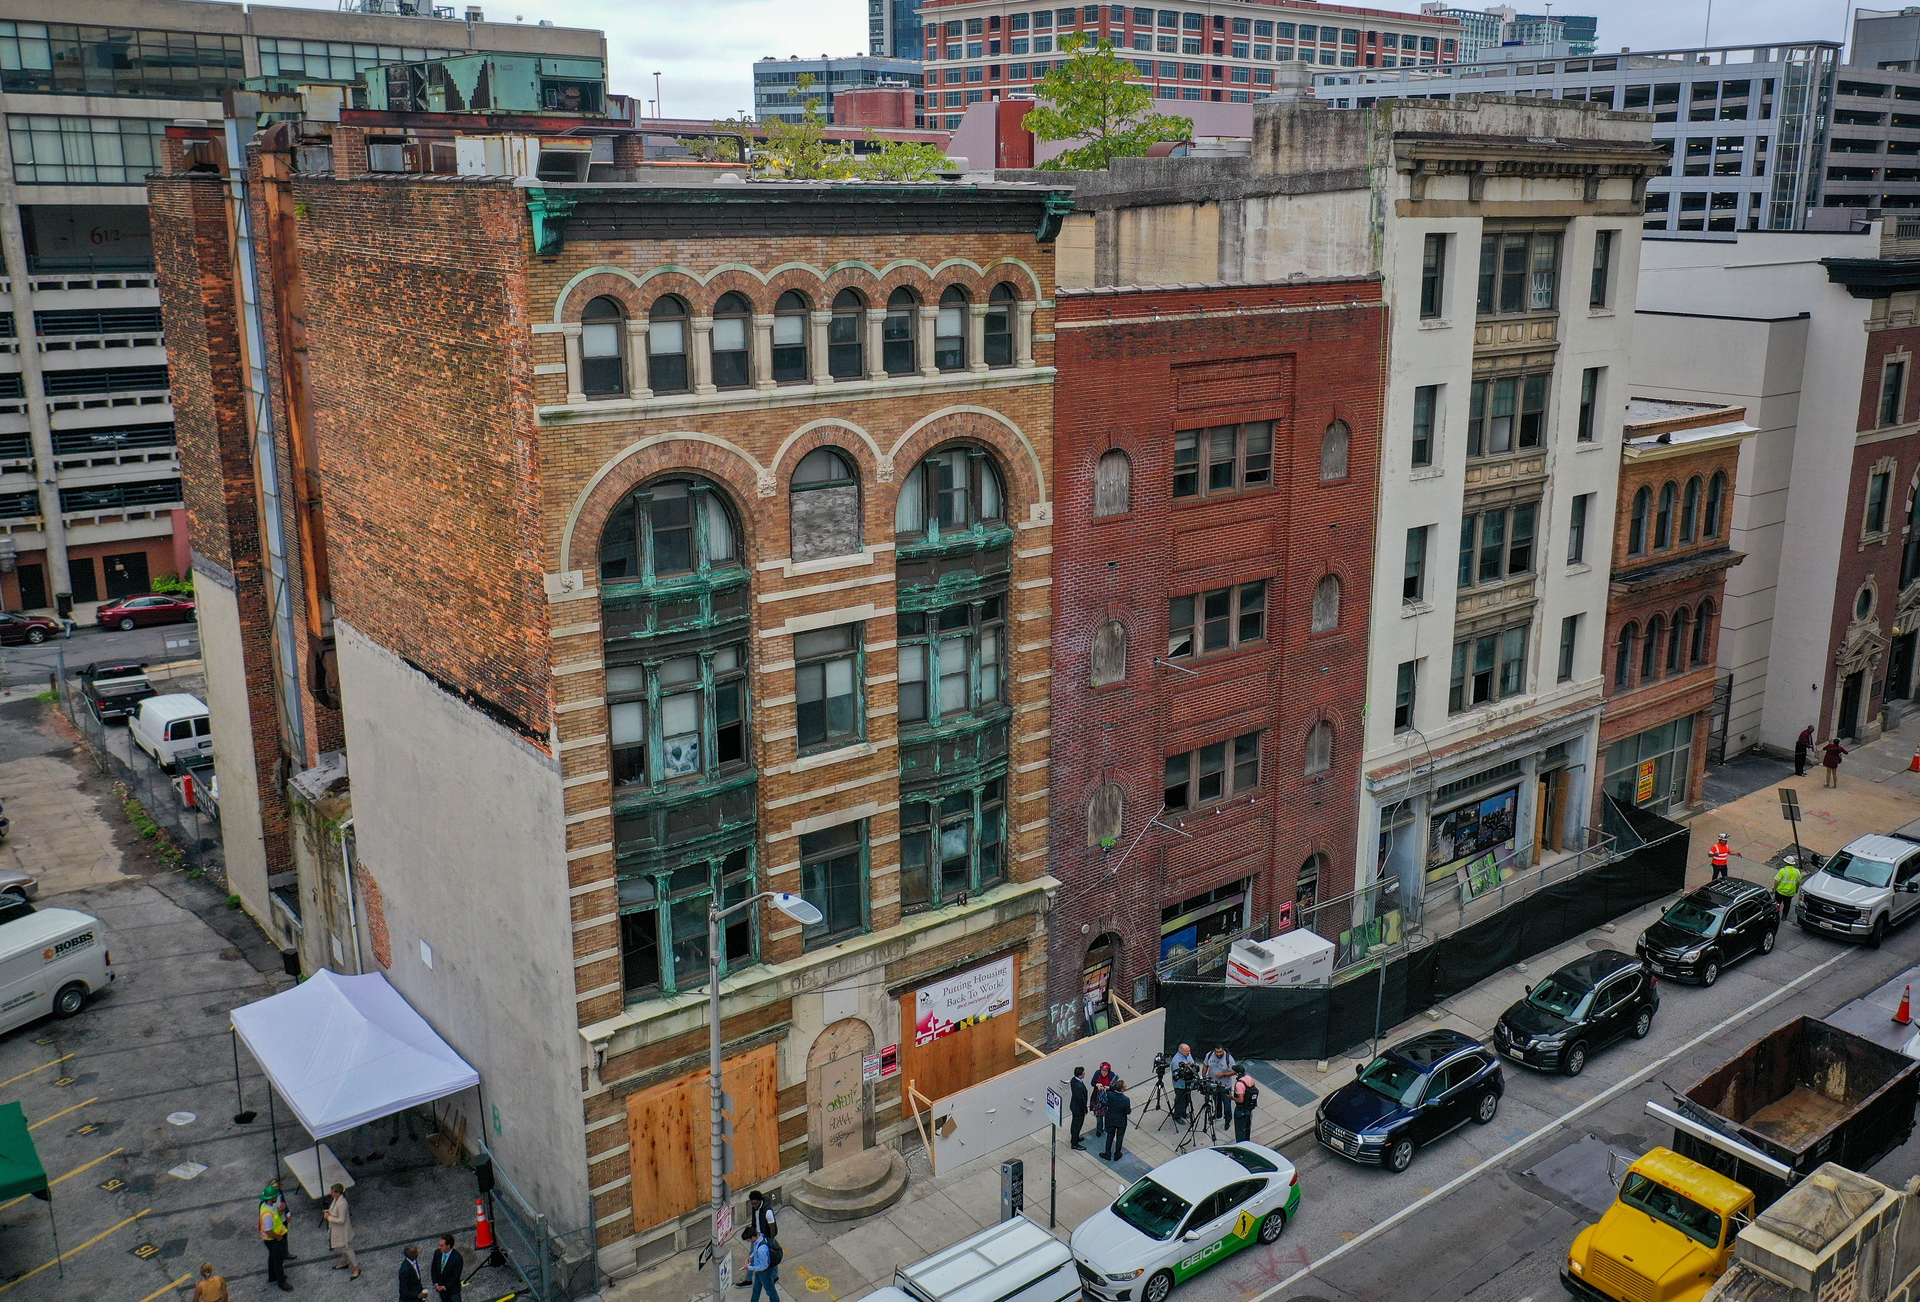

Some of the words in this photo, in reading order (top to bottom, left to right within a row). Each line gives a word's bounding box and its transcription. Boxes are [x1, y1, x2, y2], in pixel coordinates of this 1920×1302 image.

[54, 931, 94, 954] HOBBS
[943, 979, 972, 998] Putting
[974, 966, 1008, 984] Housing
[946, 994, 966, 1008] Back
[967, 988, 978, 999] To
[979, 978, 1004, 994] Work!
[1050, 998, 1077, 1024] FIX
[101, 1178, 125, 1191] 15
[134, 1244, 159, 1258] 16
[1181, 1240, 1223, 1270] GEICO
